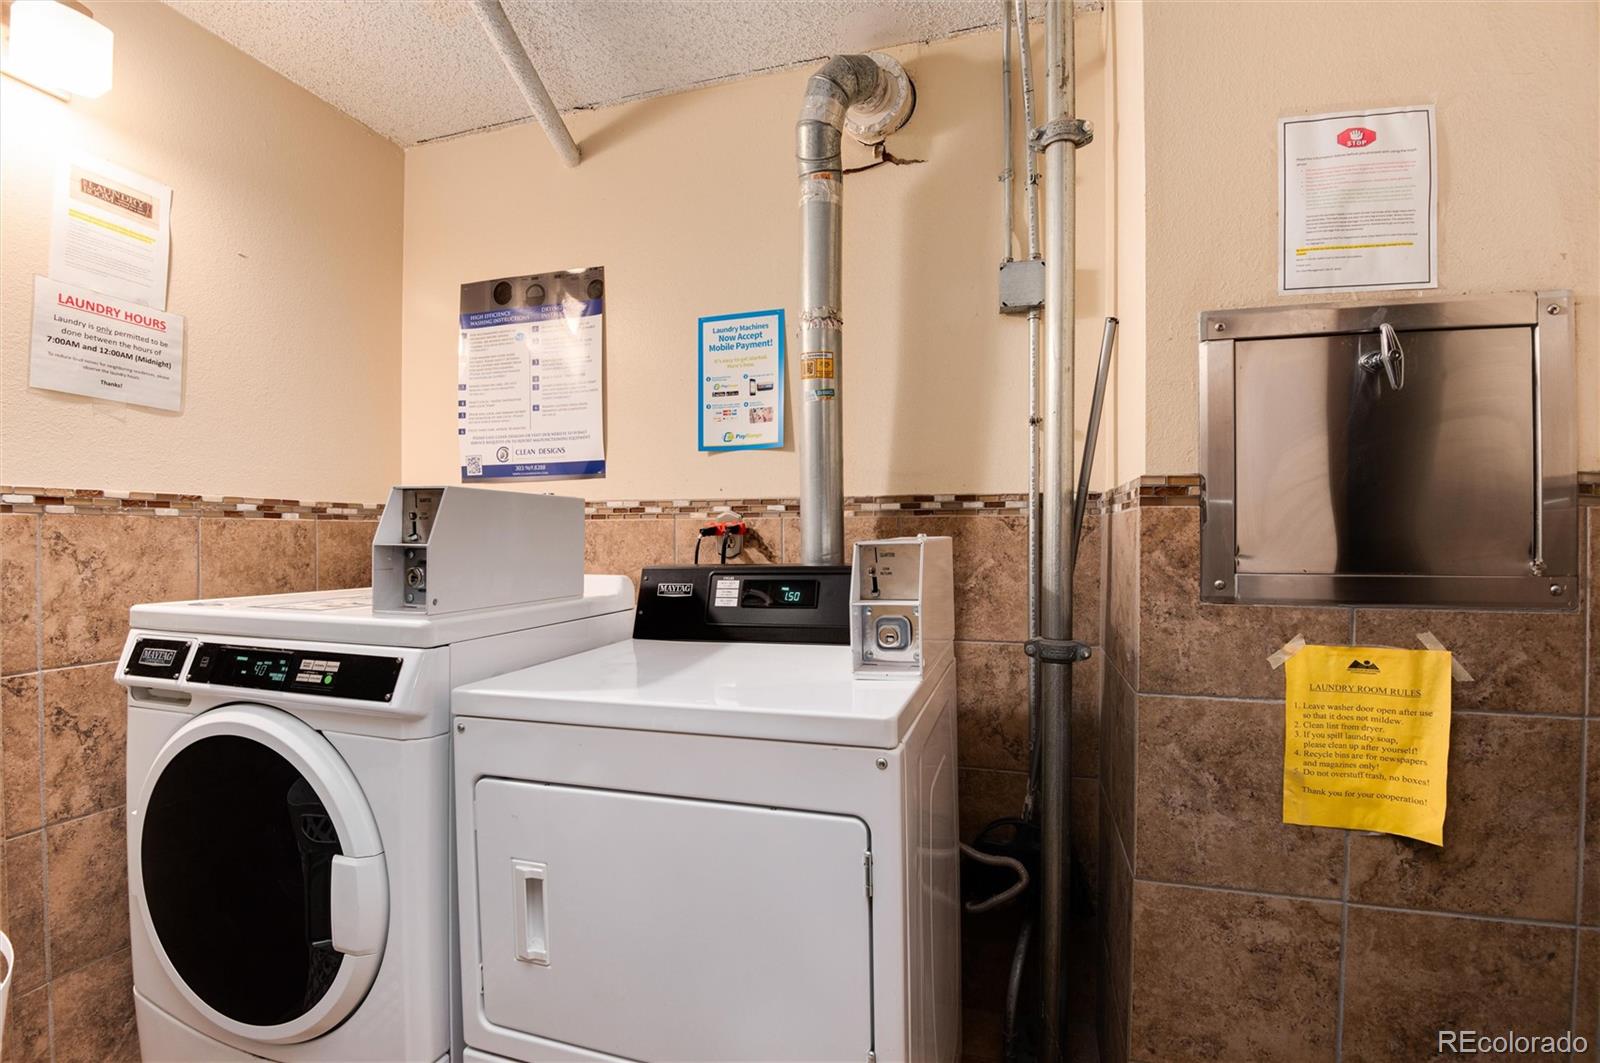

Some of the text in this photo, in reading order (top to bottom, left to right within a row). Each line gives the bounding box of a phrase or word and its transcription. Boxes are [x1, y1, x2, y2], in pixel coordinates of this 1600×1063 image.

[58, 293, 168, 331] LAUNDRY HOURS
[54, 314, 86, 328] Laundry
[96, 325, 112, 335] only
[114, 330, 150, 344] permitted
[151, 338, 158, 346] to
[160, 340, 168, 348] be
[712, 322, 768, 334] Laundry Machines
[61, 328, 82, 338] done
[84, 332, 118, 348] between
[119, 340, 132, 350] the
[132, 344, 153, 354] hours
[737, 331, 763, 340] Accept
[708, 338, 772, 352] Mobile Payment!
[46, 336, 172, 370] 7:00AM and 12:00AM (Midnight)
[100, 380, 122, 388] Thanks!
[660, 584, 690, 592] MAYTAG
[142, 650, 174, 661] MAYTAG
[254, 664, 268, 676] 40
[1310, 683, 1422, 697] LAUNDRY ROOM RULES
[1327, 704, 1355, 712] washer
[1376, 706, 1397, 716] open
[1398, 707, 1418, 716] after
[1336, 713, 1354, 721] does
[1370, 716, 1404, 724] mildew.
[1341, 722, 1362, 730] from
[1361, 724, 1385, 734] dryer.
[1303, 730, 1310, 738] If
[1327, 731, 1343, 740] spill
[1345, 732, 1375, 742] laundry
[1377, 736, 1399, 744] soap,
[1304, 742, 1326, 750] please
[1360, 743, 1379, 751] after
[1381, 746, 1418, 755] yourself!
[1304, 750, 1334, 759] Recycle
[1334, 751, 1350, 759] bins
[1366, 752, 1378, 760] for
[1380, 755, 1428, 766] newspapers
[1319, 762, 1356, 770] magazines
[1358, 762, 1380, 771] only!
[1304, 768, 1316, 776] Do
[1330, 771, 1366, 780] overstuff
[1366, 772, 1387, 780] trash,
[1402, 775, 1430, 786] boxes!
[1302, 786, 1327, 796] Thank
[1328, 790, 1343, 798] you
[1344, 789, 1356, 798] for
[1376, 793, 1428, 806] cooperation!
